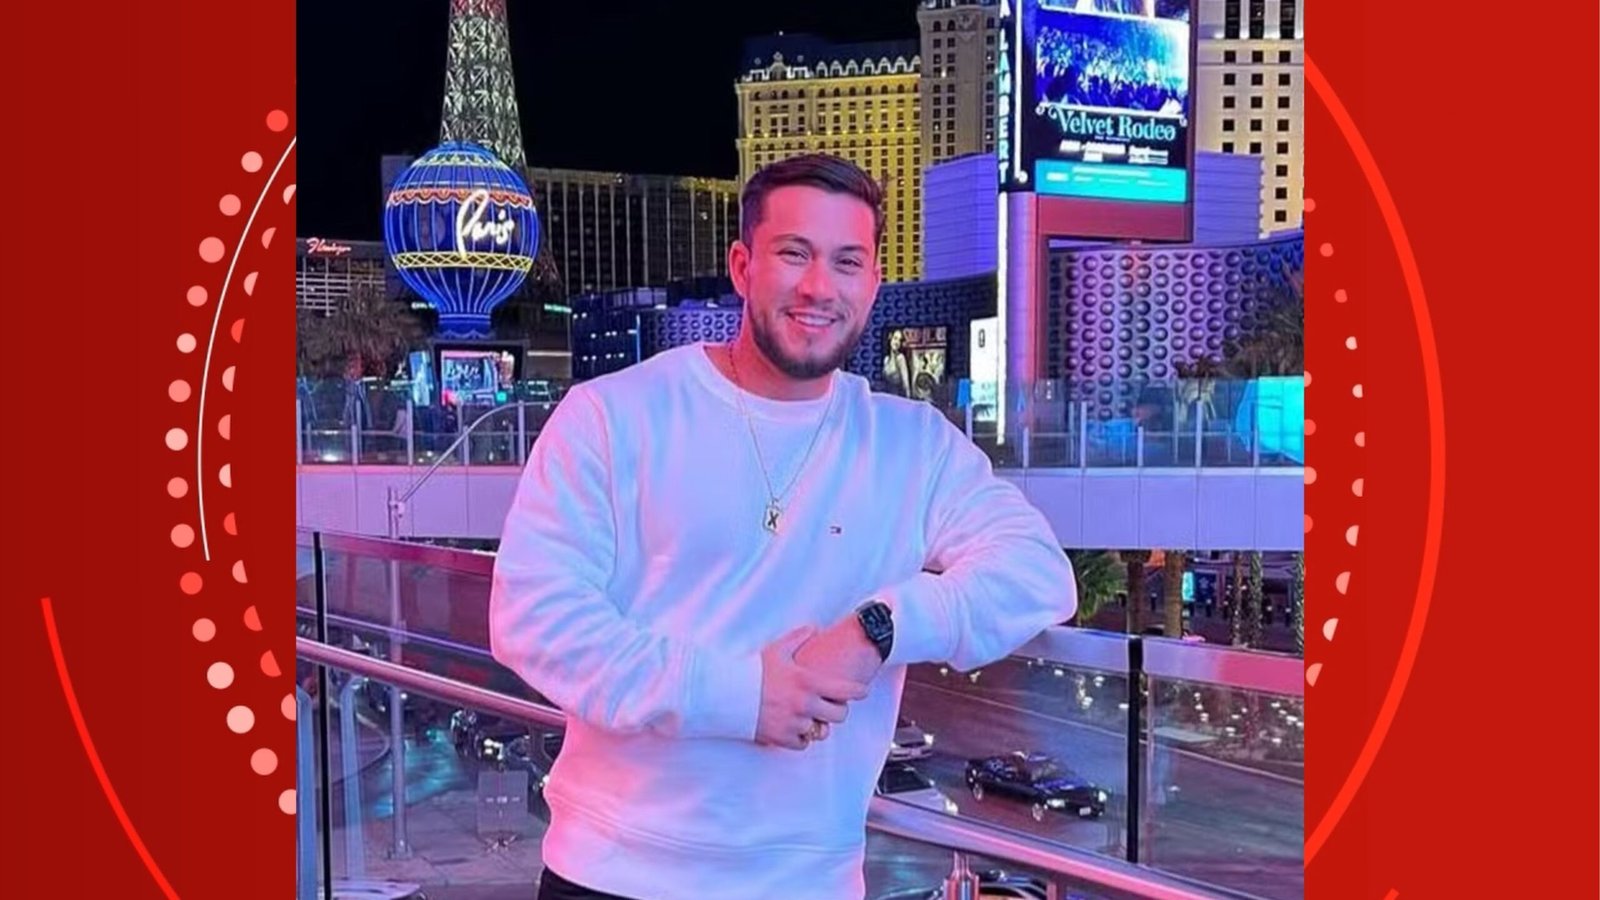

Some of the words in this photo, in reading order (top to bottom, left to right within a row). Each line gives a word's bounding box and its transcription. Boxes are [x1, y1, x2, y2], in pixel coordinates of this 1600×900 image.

[998, 28, 1011, 184] LAMBERT
[1048, 105, 1114, 135] Velvet
[1119, 115, 1177, 141] Rodeo
[456, 189, 515, 259] Paris
[767, 510, 779, 529] X
